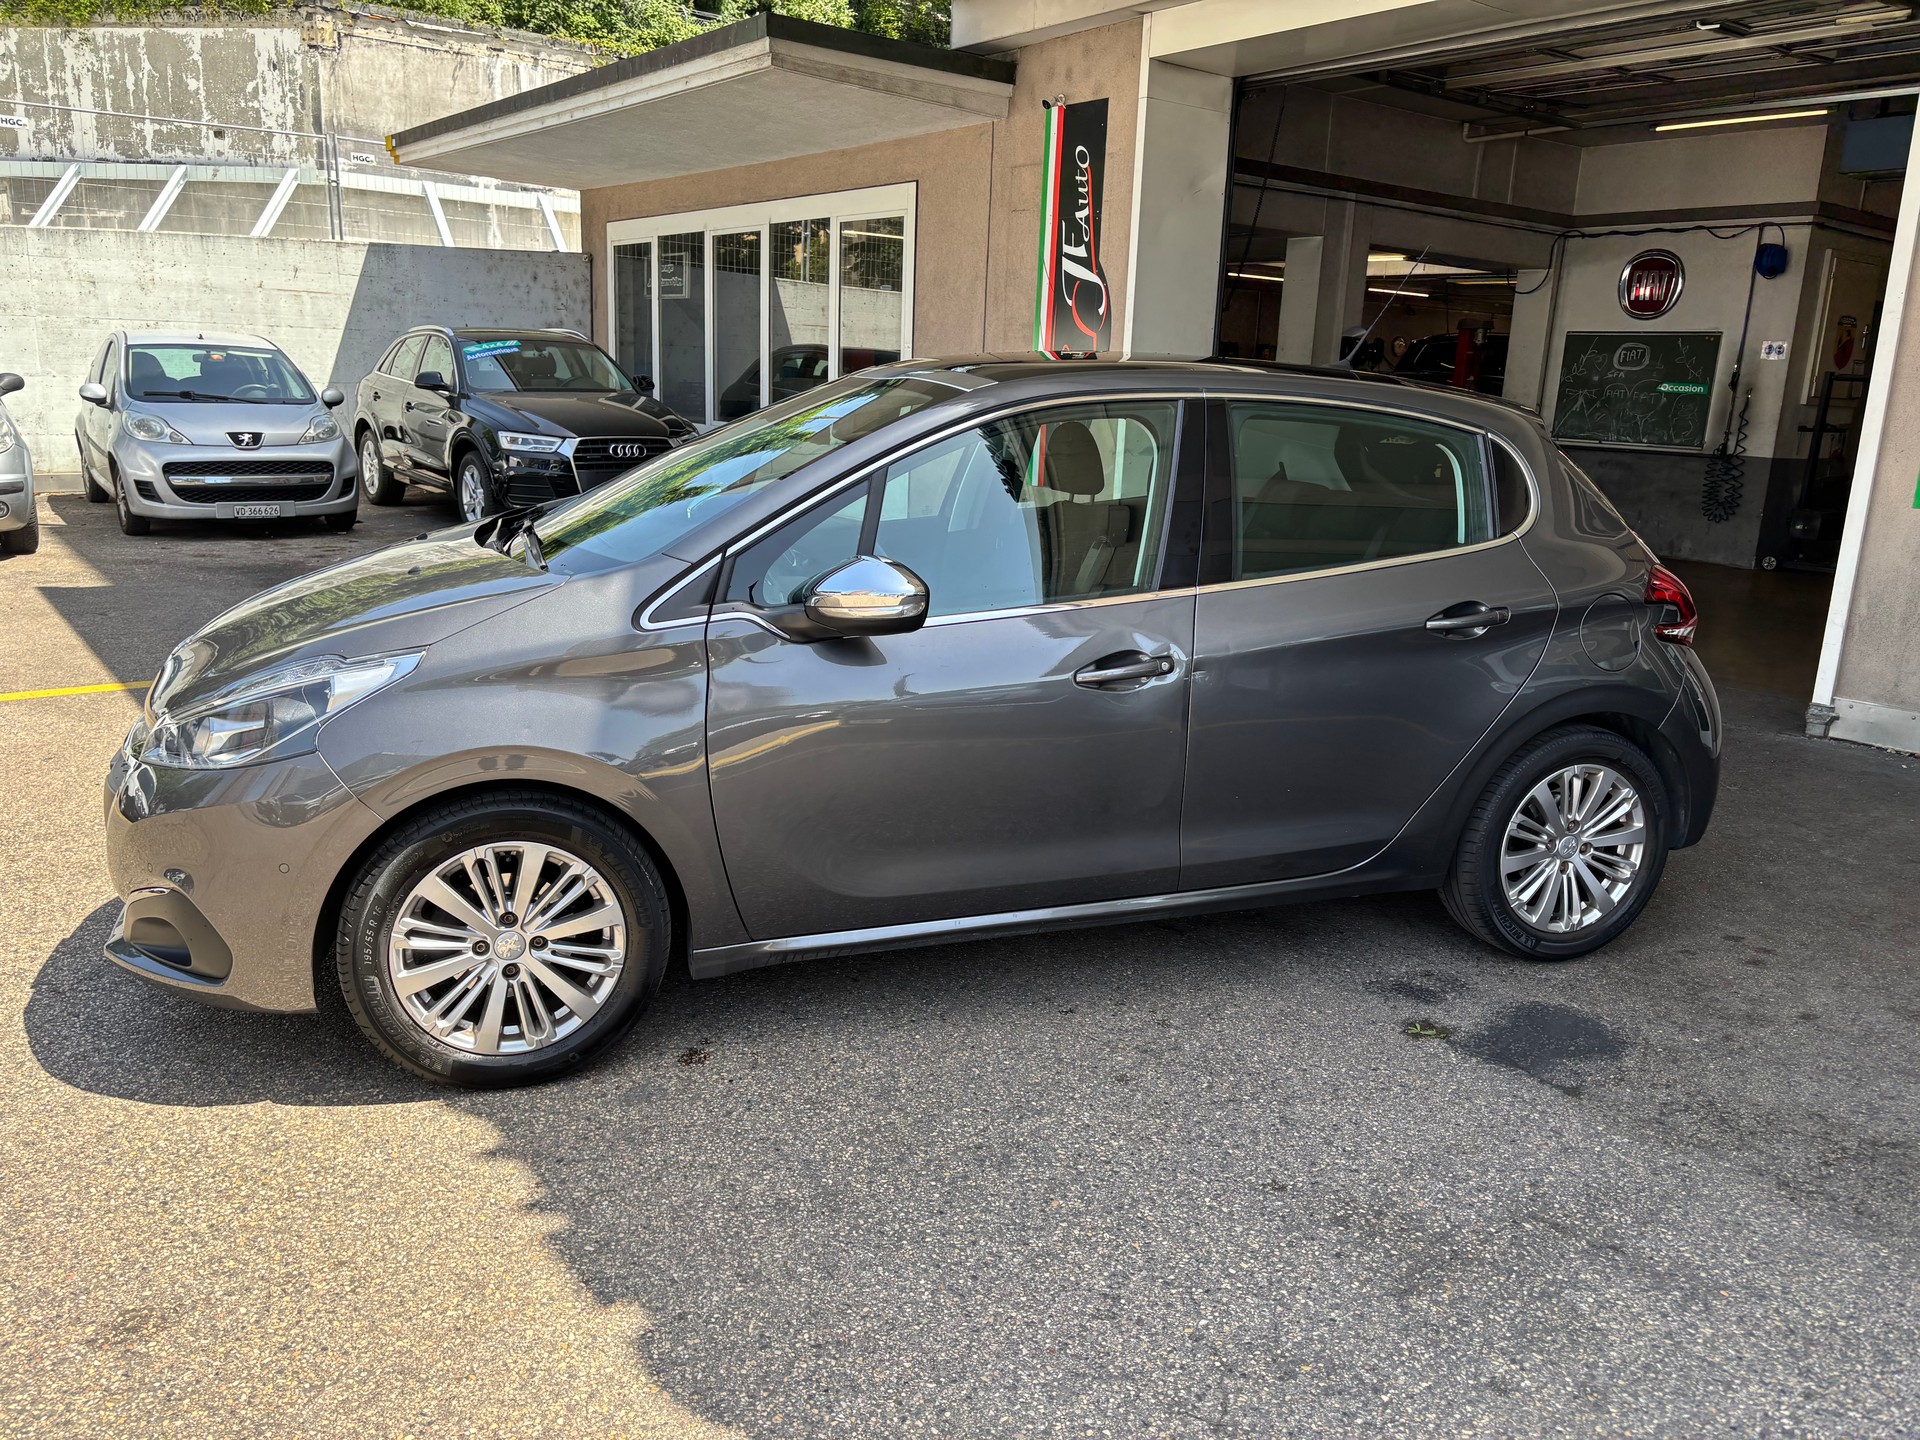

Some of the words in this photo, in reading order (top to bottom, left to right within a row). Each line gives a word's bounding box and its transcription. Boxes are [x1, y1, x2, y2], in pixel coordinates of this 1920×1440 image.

[0, 117, 23, 127] HGC
[352, 154, 371, 163] HGC
[1630, 270, 1673, 302] FIAT
[466, 346, 520, 361] Automatique
[1620, 349, 1645, 363] FIAT
[1660, 383, 1704, 393] Occasion
[372, 905, 383, 918] 16
[371, 918, 378, 929] R
[363, 928, 376, 965] 195/55
